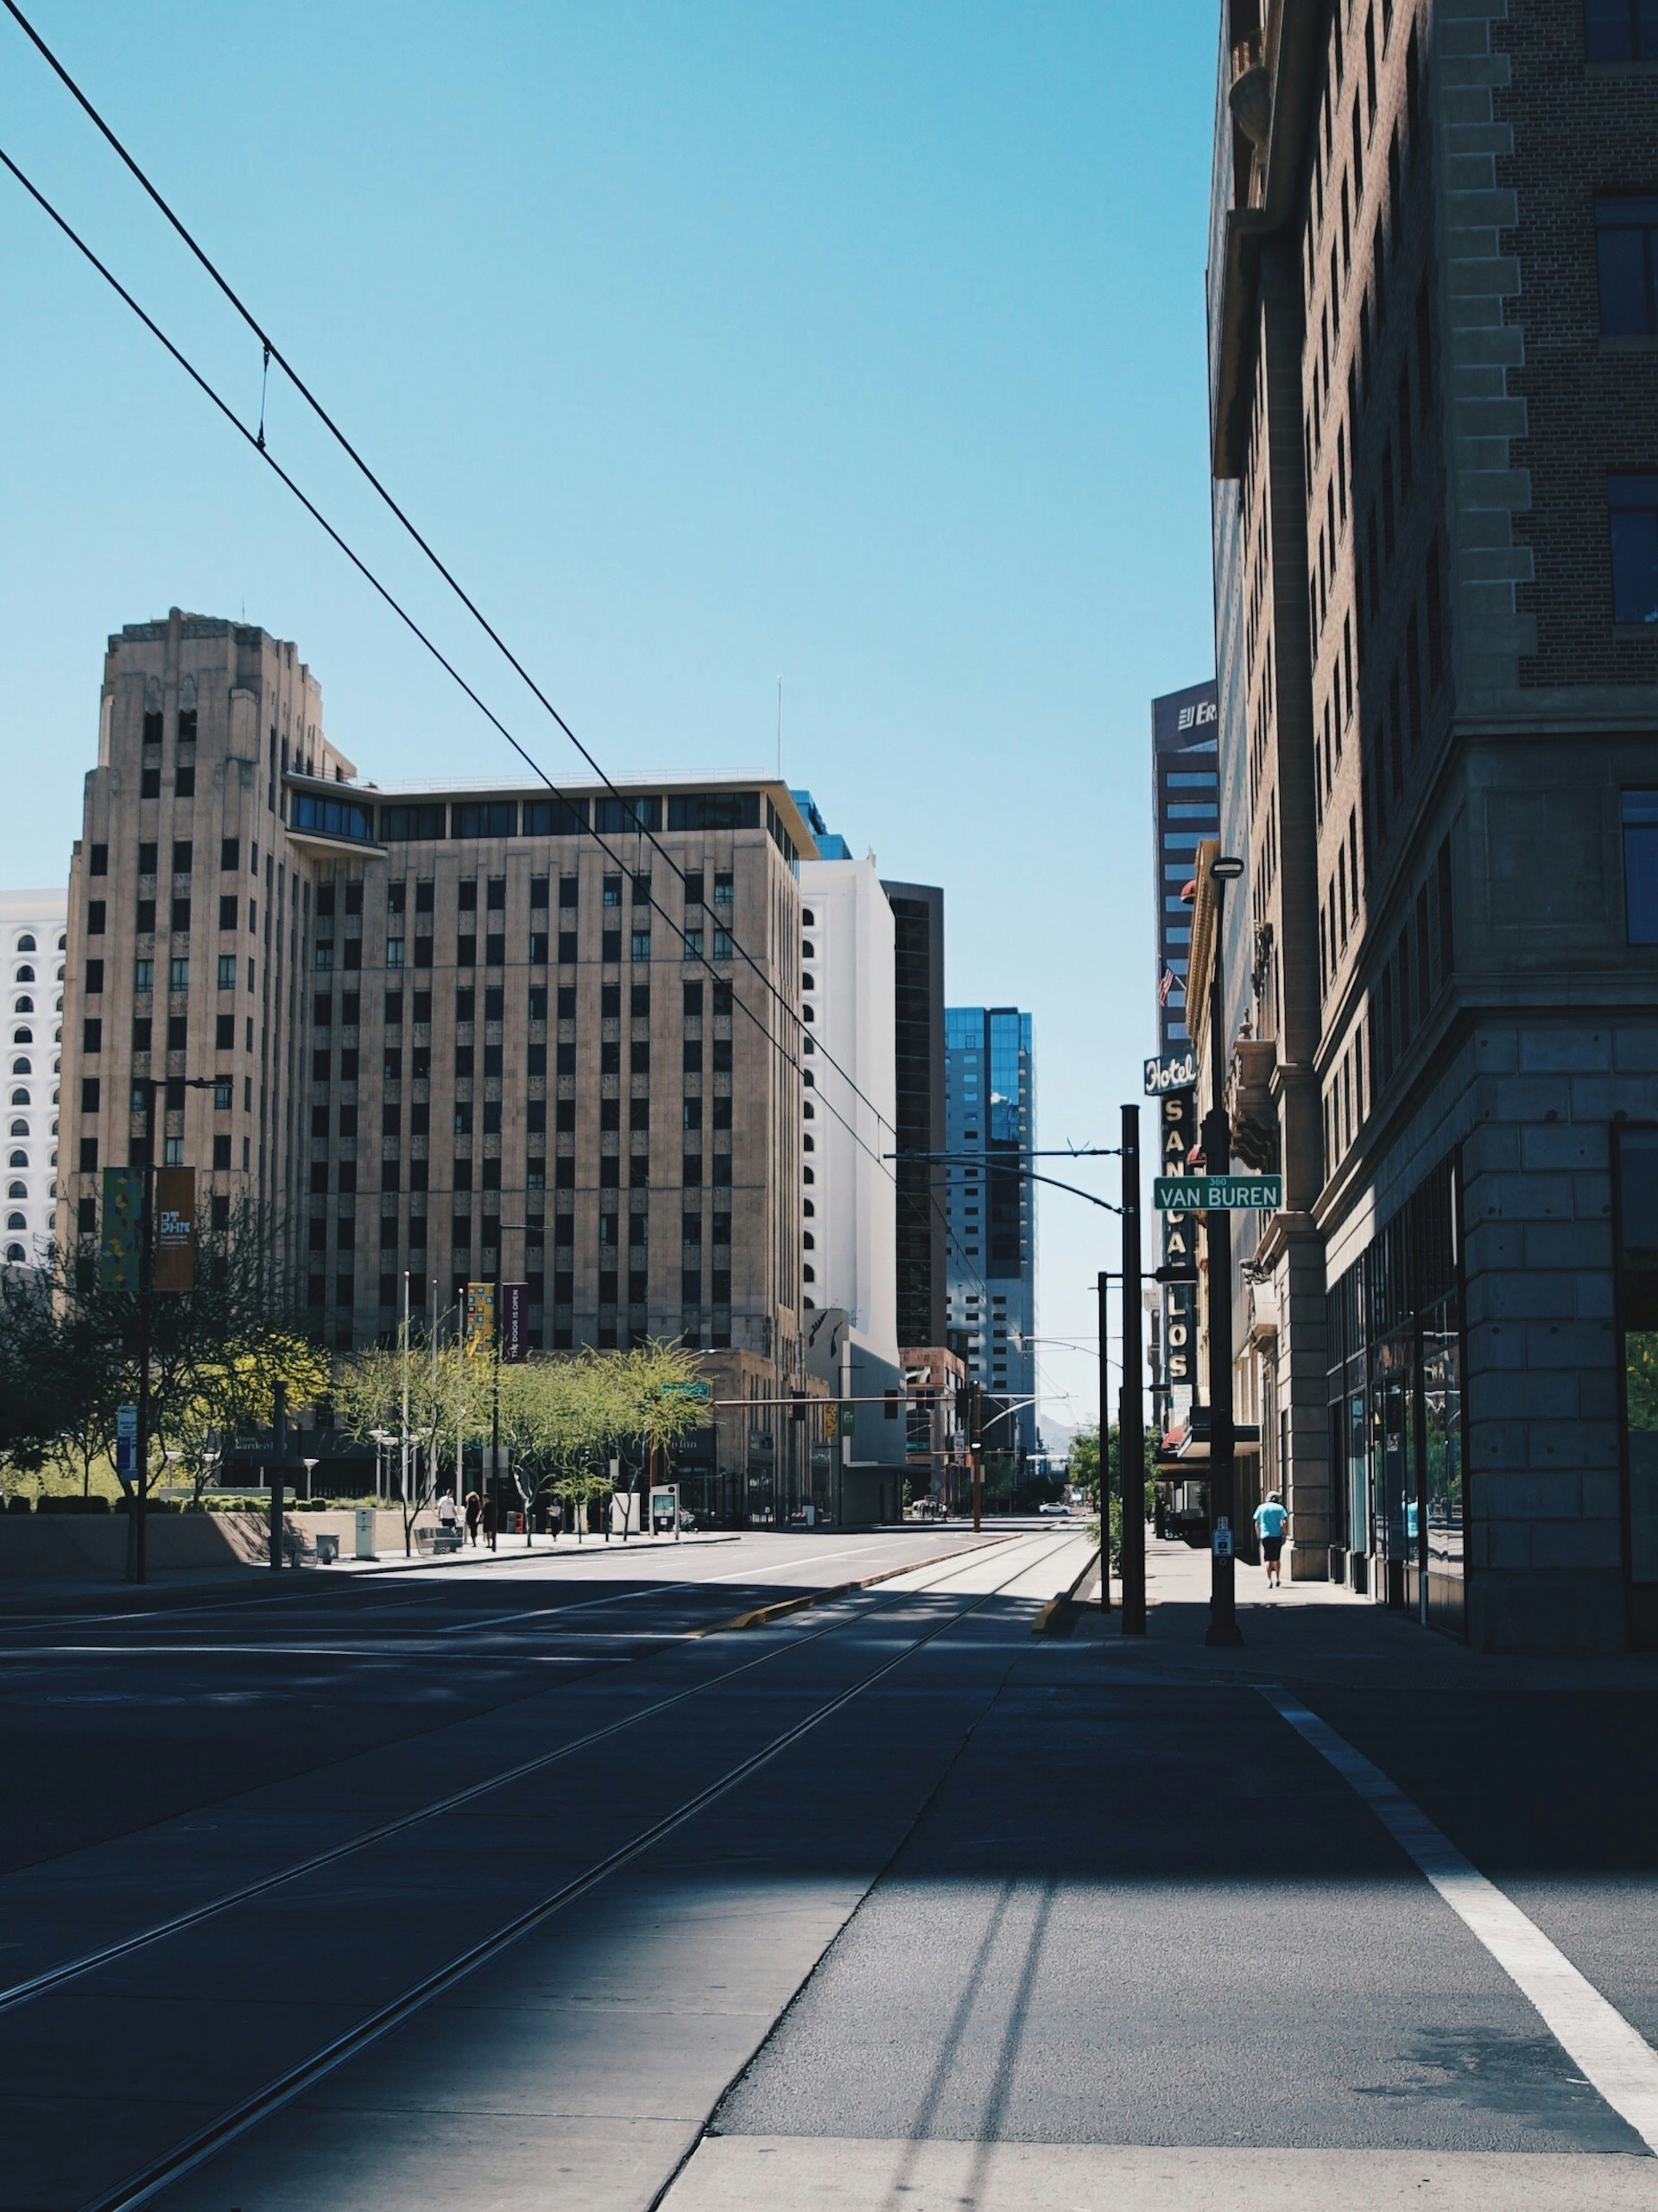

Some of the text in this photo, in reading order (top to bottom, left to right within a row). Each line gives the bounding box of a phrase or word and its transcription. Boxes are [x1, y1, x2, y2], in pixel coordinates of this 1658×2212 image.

[1146, 1053, 1197, 1091] Hotel
[1160, 1187, 1277, 1207] VAN BUREN
[1209, 1178, 1227, 1187] 300
[1167, 1209, 1187, 1378] CALOS
